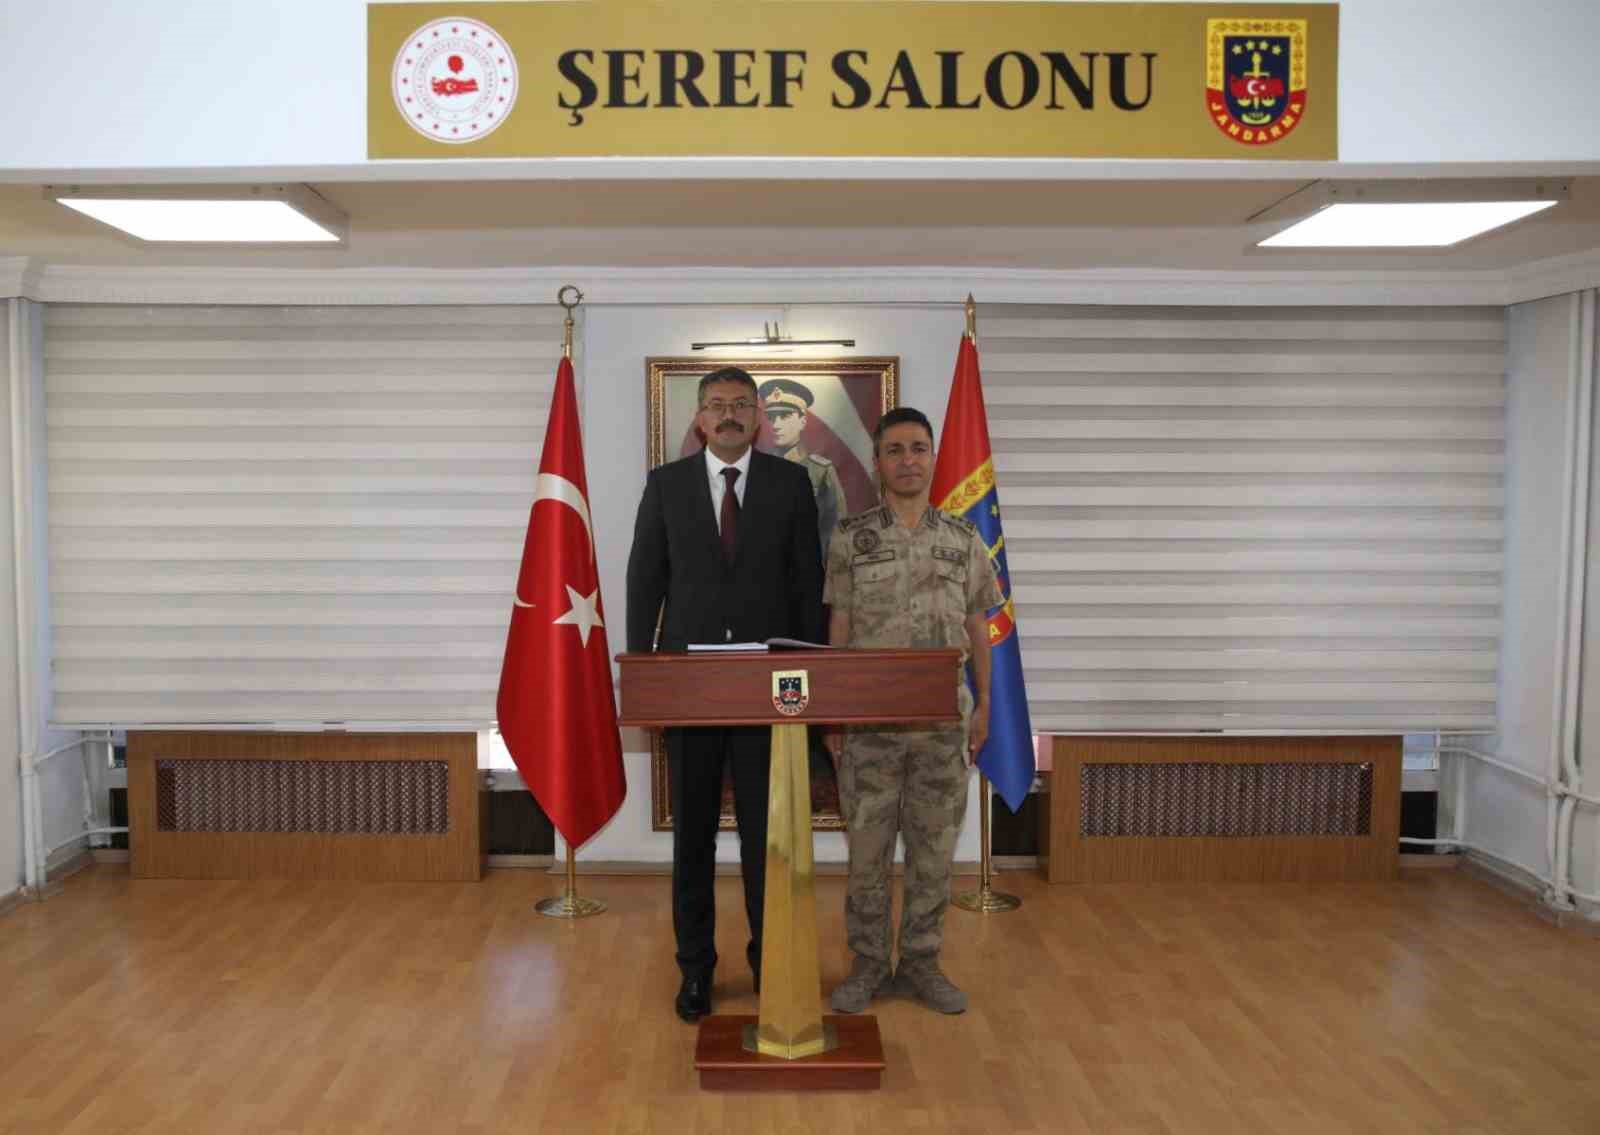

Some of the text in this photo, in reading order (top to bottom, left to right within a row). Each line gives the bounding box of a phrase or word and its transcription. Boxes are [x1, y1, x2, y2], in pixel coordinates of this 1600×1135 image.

[557, 50, 807, 126] ŞEREF
[831, 50, 1158, 112] SALONU
[1211, 102, 1302, 142] JANDARMA
